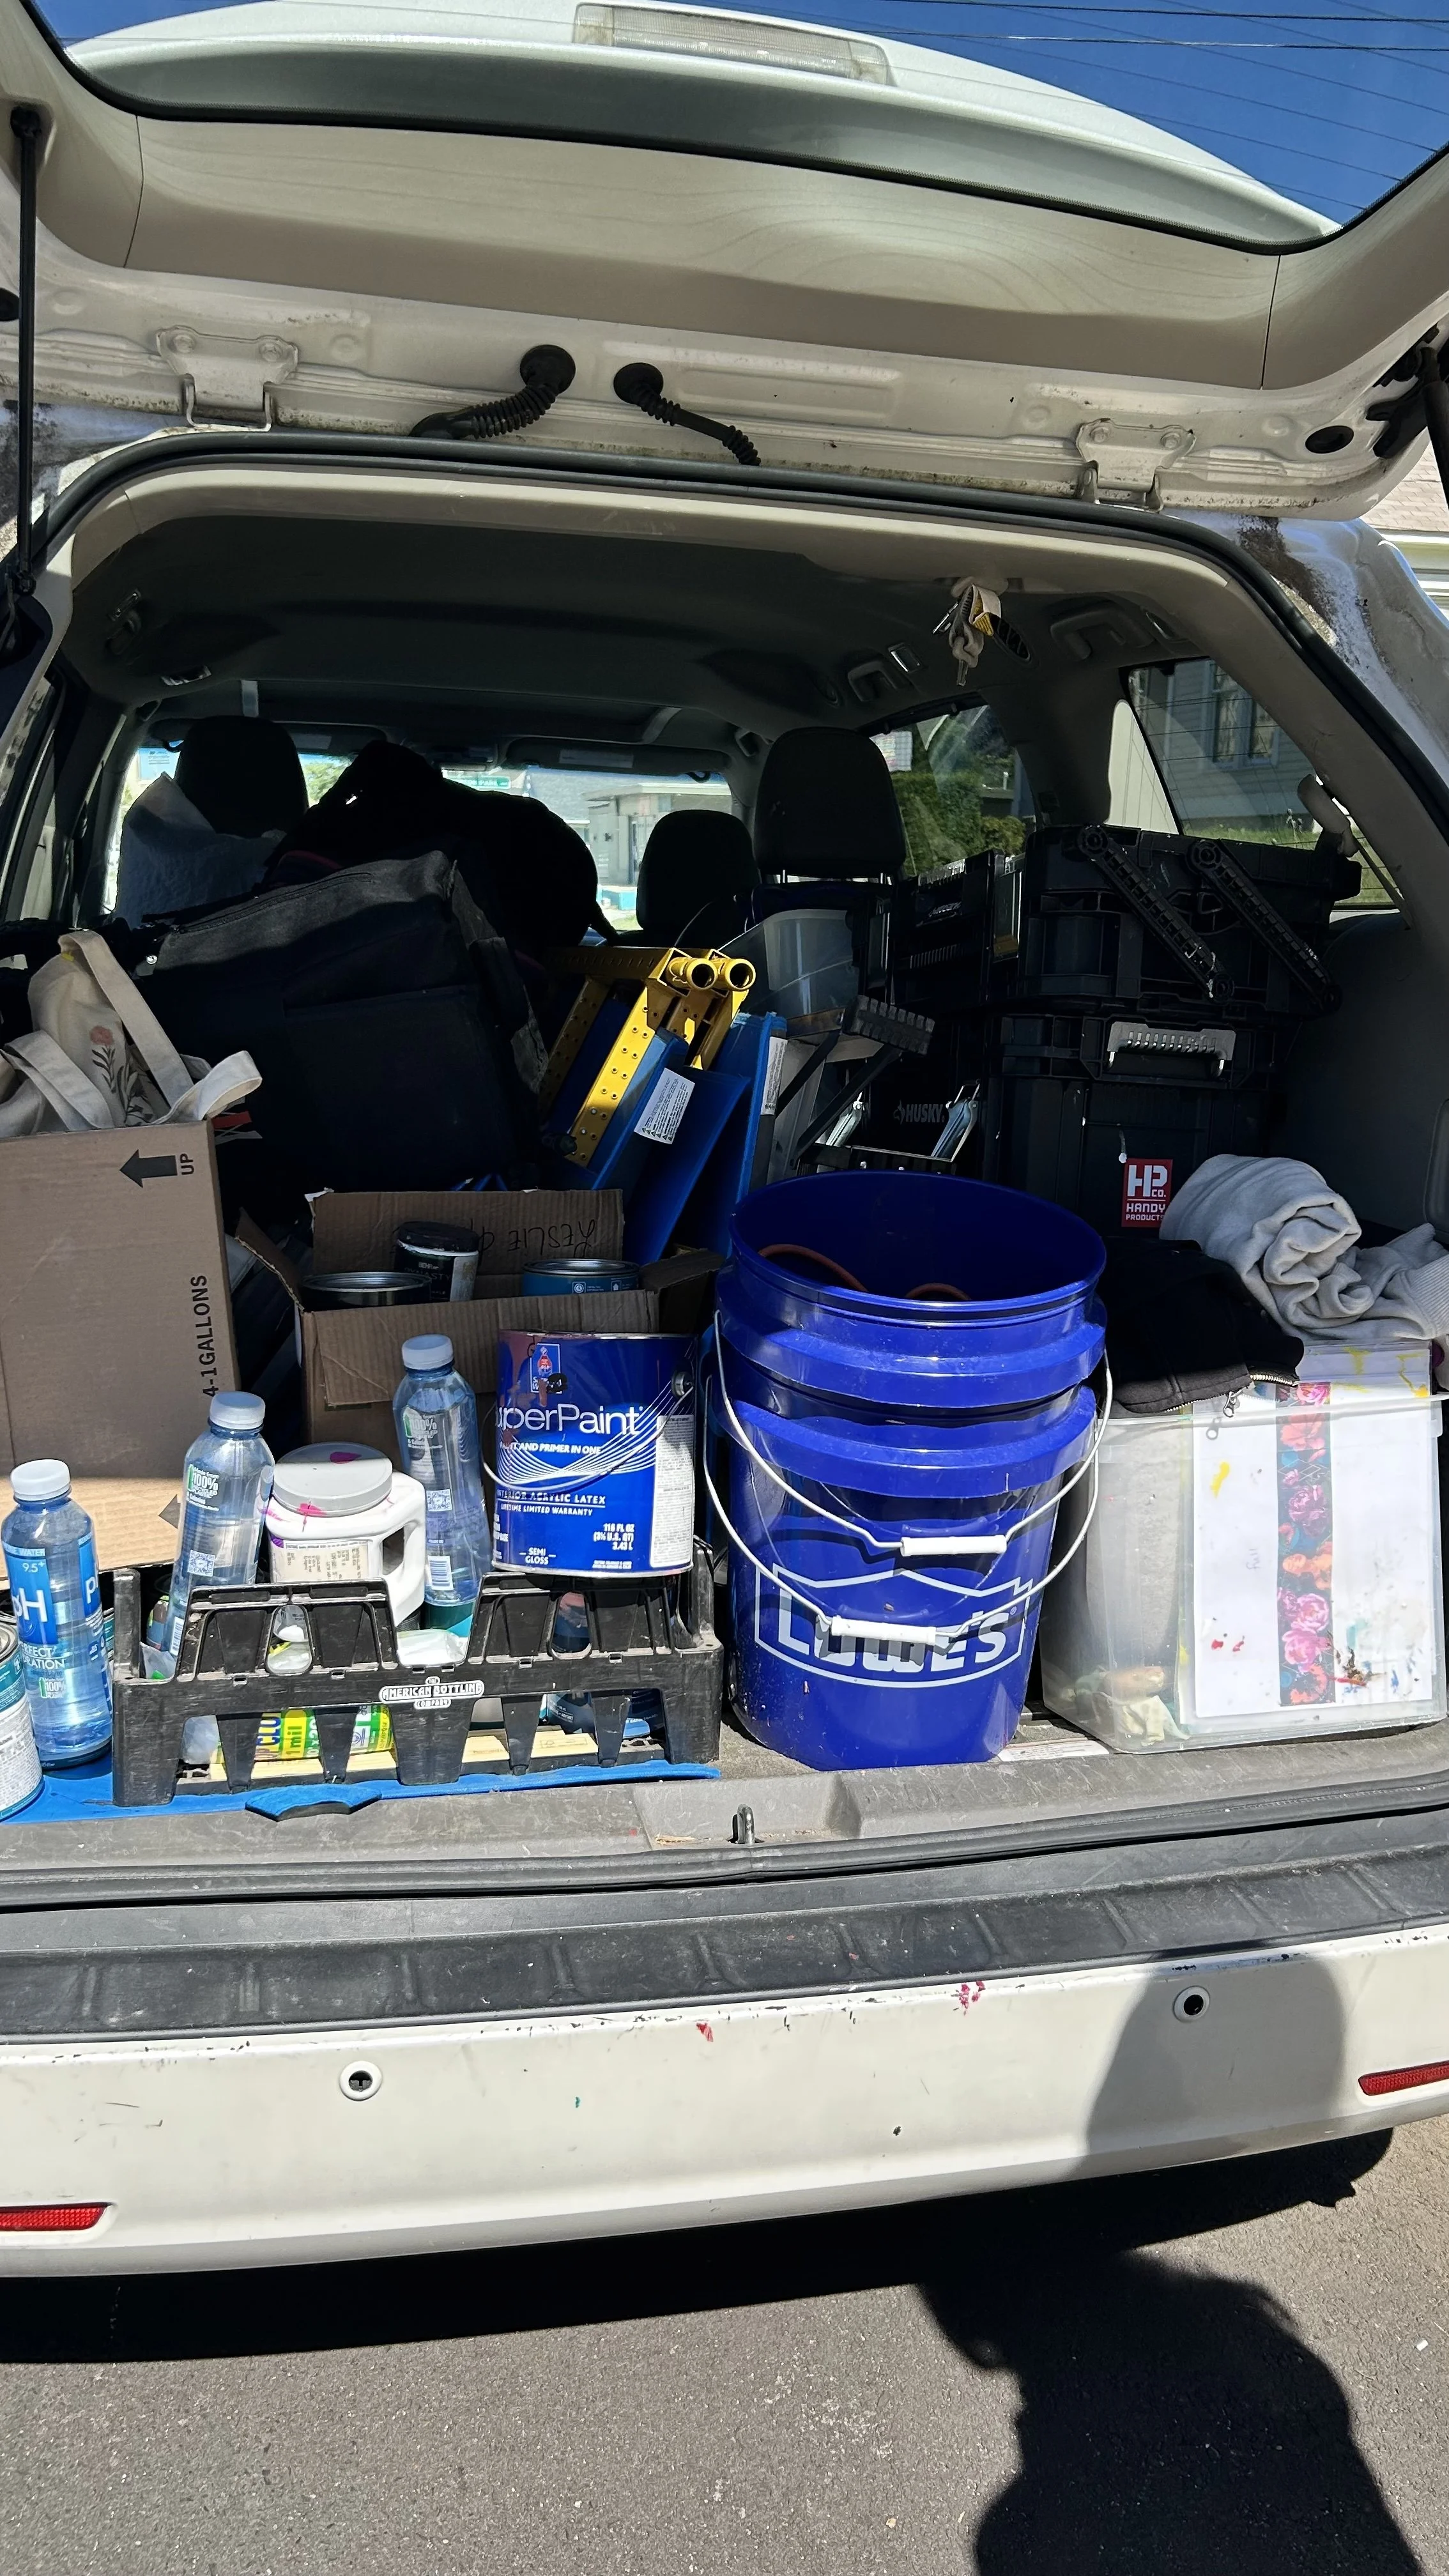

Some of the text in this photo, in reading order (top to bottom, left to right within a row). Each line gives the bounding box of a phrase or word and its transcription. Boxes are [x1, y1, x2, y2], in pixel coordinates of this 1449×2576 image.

[905, 1103, 944, 1123] HUSKY
[180, 1153, 195, 1175] UP
[1151, 1189, 1167, 1197] CO.
[1126, 1203, 1166, 1213] HANDY
[495, 1403, 640, 1436] uperPaint
[519, 1442, 539, 1452] AND
[539, 1443, 570, 1453] PRIMER
[582, 1446, 602, 1454] ONE
[194, 1473, 218, 1491] 100%
[530, 1492, 571, 1503] ACRYLIC
[574, 1495, 606, 1505] LATEX
[501, 1503, 593, 1516] LIFETIME LIMITED WARRANTY
[616, 1523, 625, 1533] FL
[625, 1523, 635, 1533] OZ
[19, 1548, 45, 1557] WATER
[528, 1547, 546, 1556] SEMI
[628, 1541, 633, 1551] L
[525, 1555, 549, 1565] GLOSS
[778, 1587, 1011, 1673] LOWE'S
[21, 1643, 53, 1658] ERFECT
[22, 1653, 65, 1669] DRATION
[383, 1682, 483, 1701] AMERICAN BOTTLING
[416, 1698, 448, 1708] COMPANY
